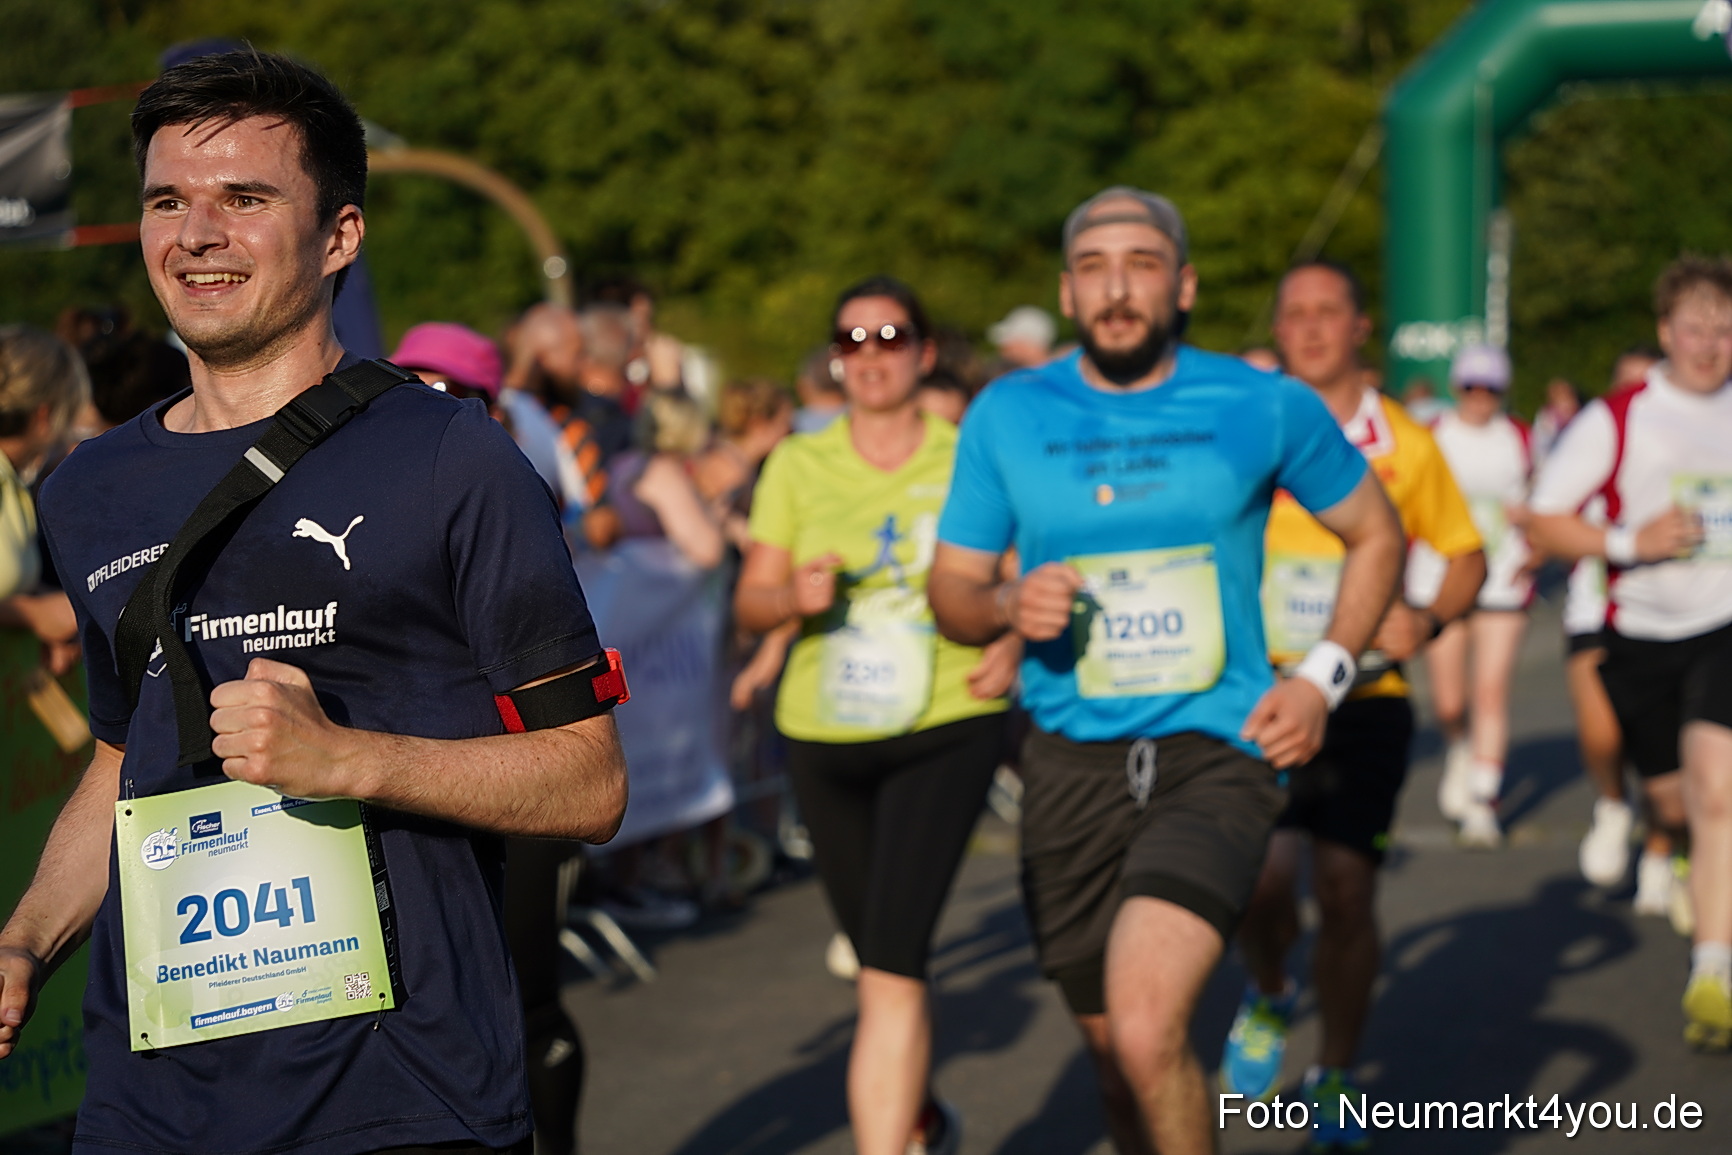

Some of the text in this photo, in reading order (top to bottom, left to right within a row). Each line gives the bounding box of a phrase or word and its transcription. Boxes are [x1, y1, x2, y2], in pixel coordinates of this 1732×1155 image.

[185, 601, 338, 642] Firmenlauf
[1103, 610, 1184, 640] 1200
[243, 628, 337, 653] neumarkt
[181, 827, 249, 855] Firmenlauf
[208, 841, 249, 857] neumarkt
[176, 876, 316, 945] 2041
[157, 936, 360, 983] Benedikt Naumann
[209, 966, 307, 988] Pfleiderer Deutschland GmbH
[194, 1003, 273, 1027] firmenlauf.bayern
